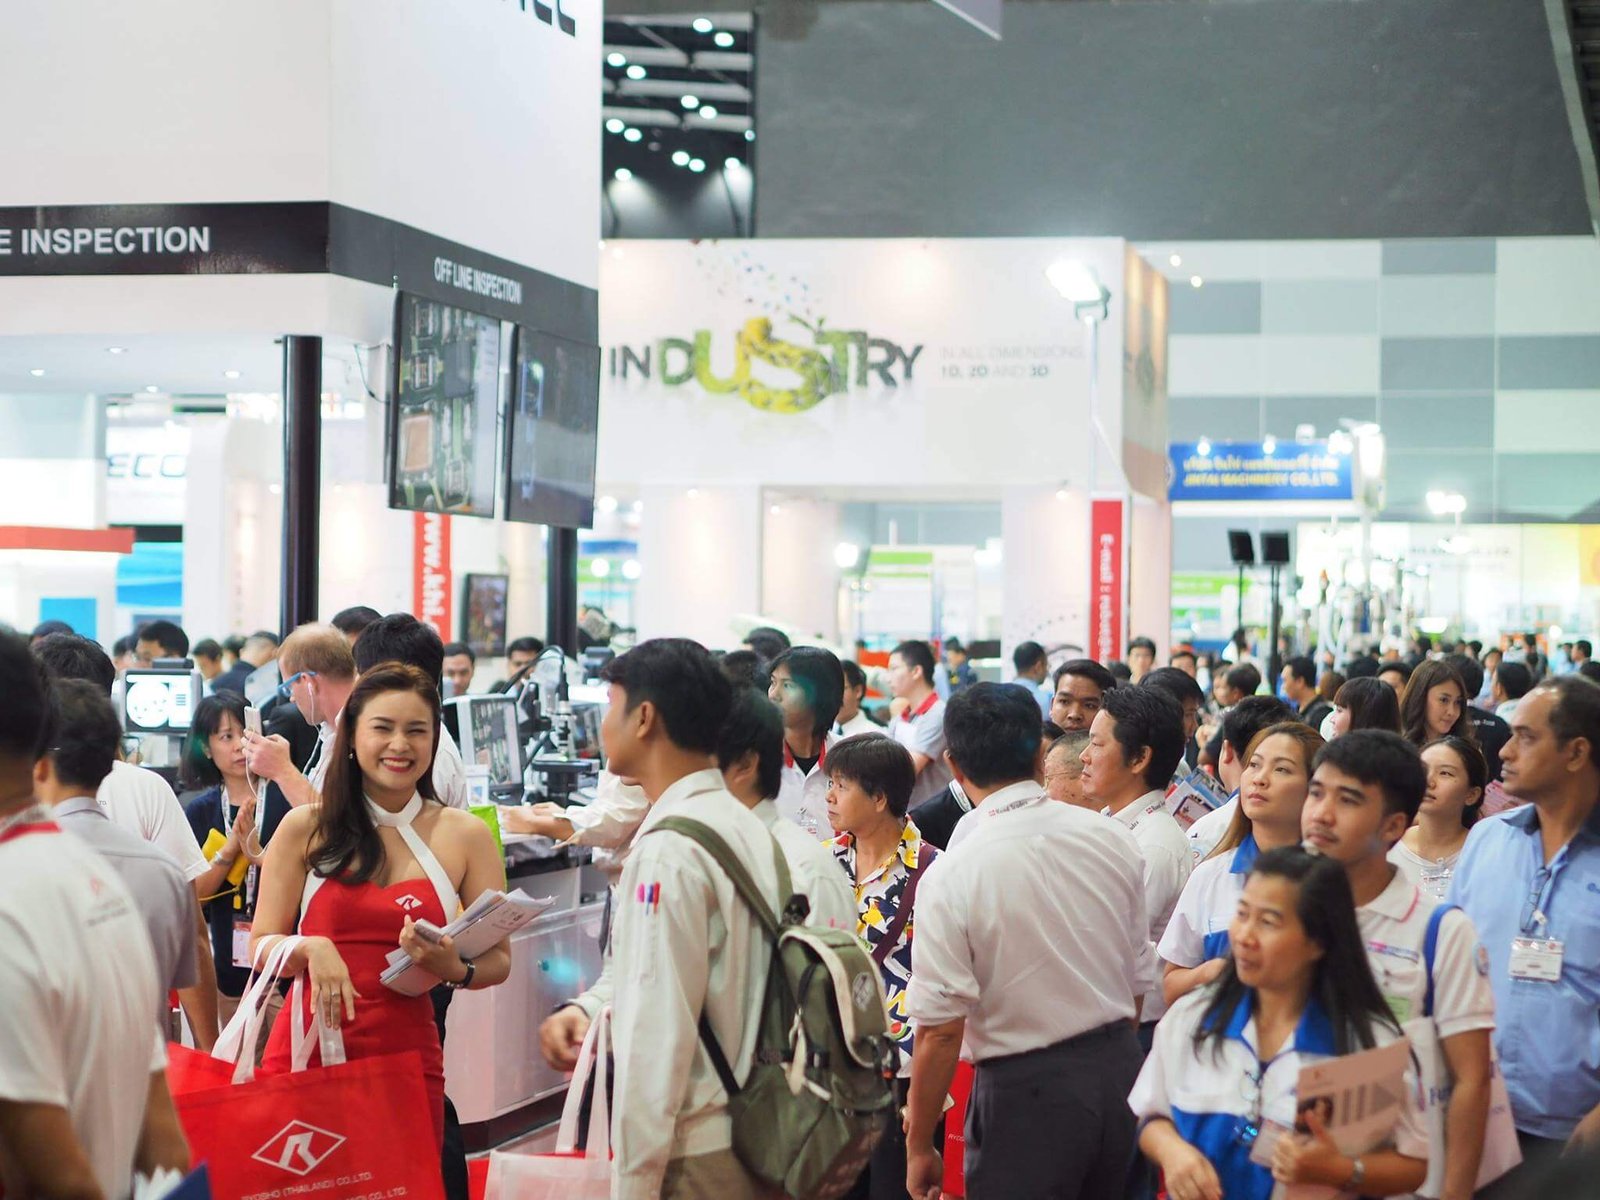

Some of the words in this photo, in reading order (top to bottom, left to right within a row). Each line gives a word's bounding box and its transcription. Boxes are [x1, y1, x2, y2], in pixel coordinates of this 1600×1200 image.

[21, 226, 210, 254] INSPECTION
[434, 256, 452, 284] OFF
[453, 263, 473, 292] LINE
[473, 269, 522, 304] INSPECTION
[609, 316, 924, 414] INDUSTRY
